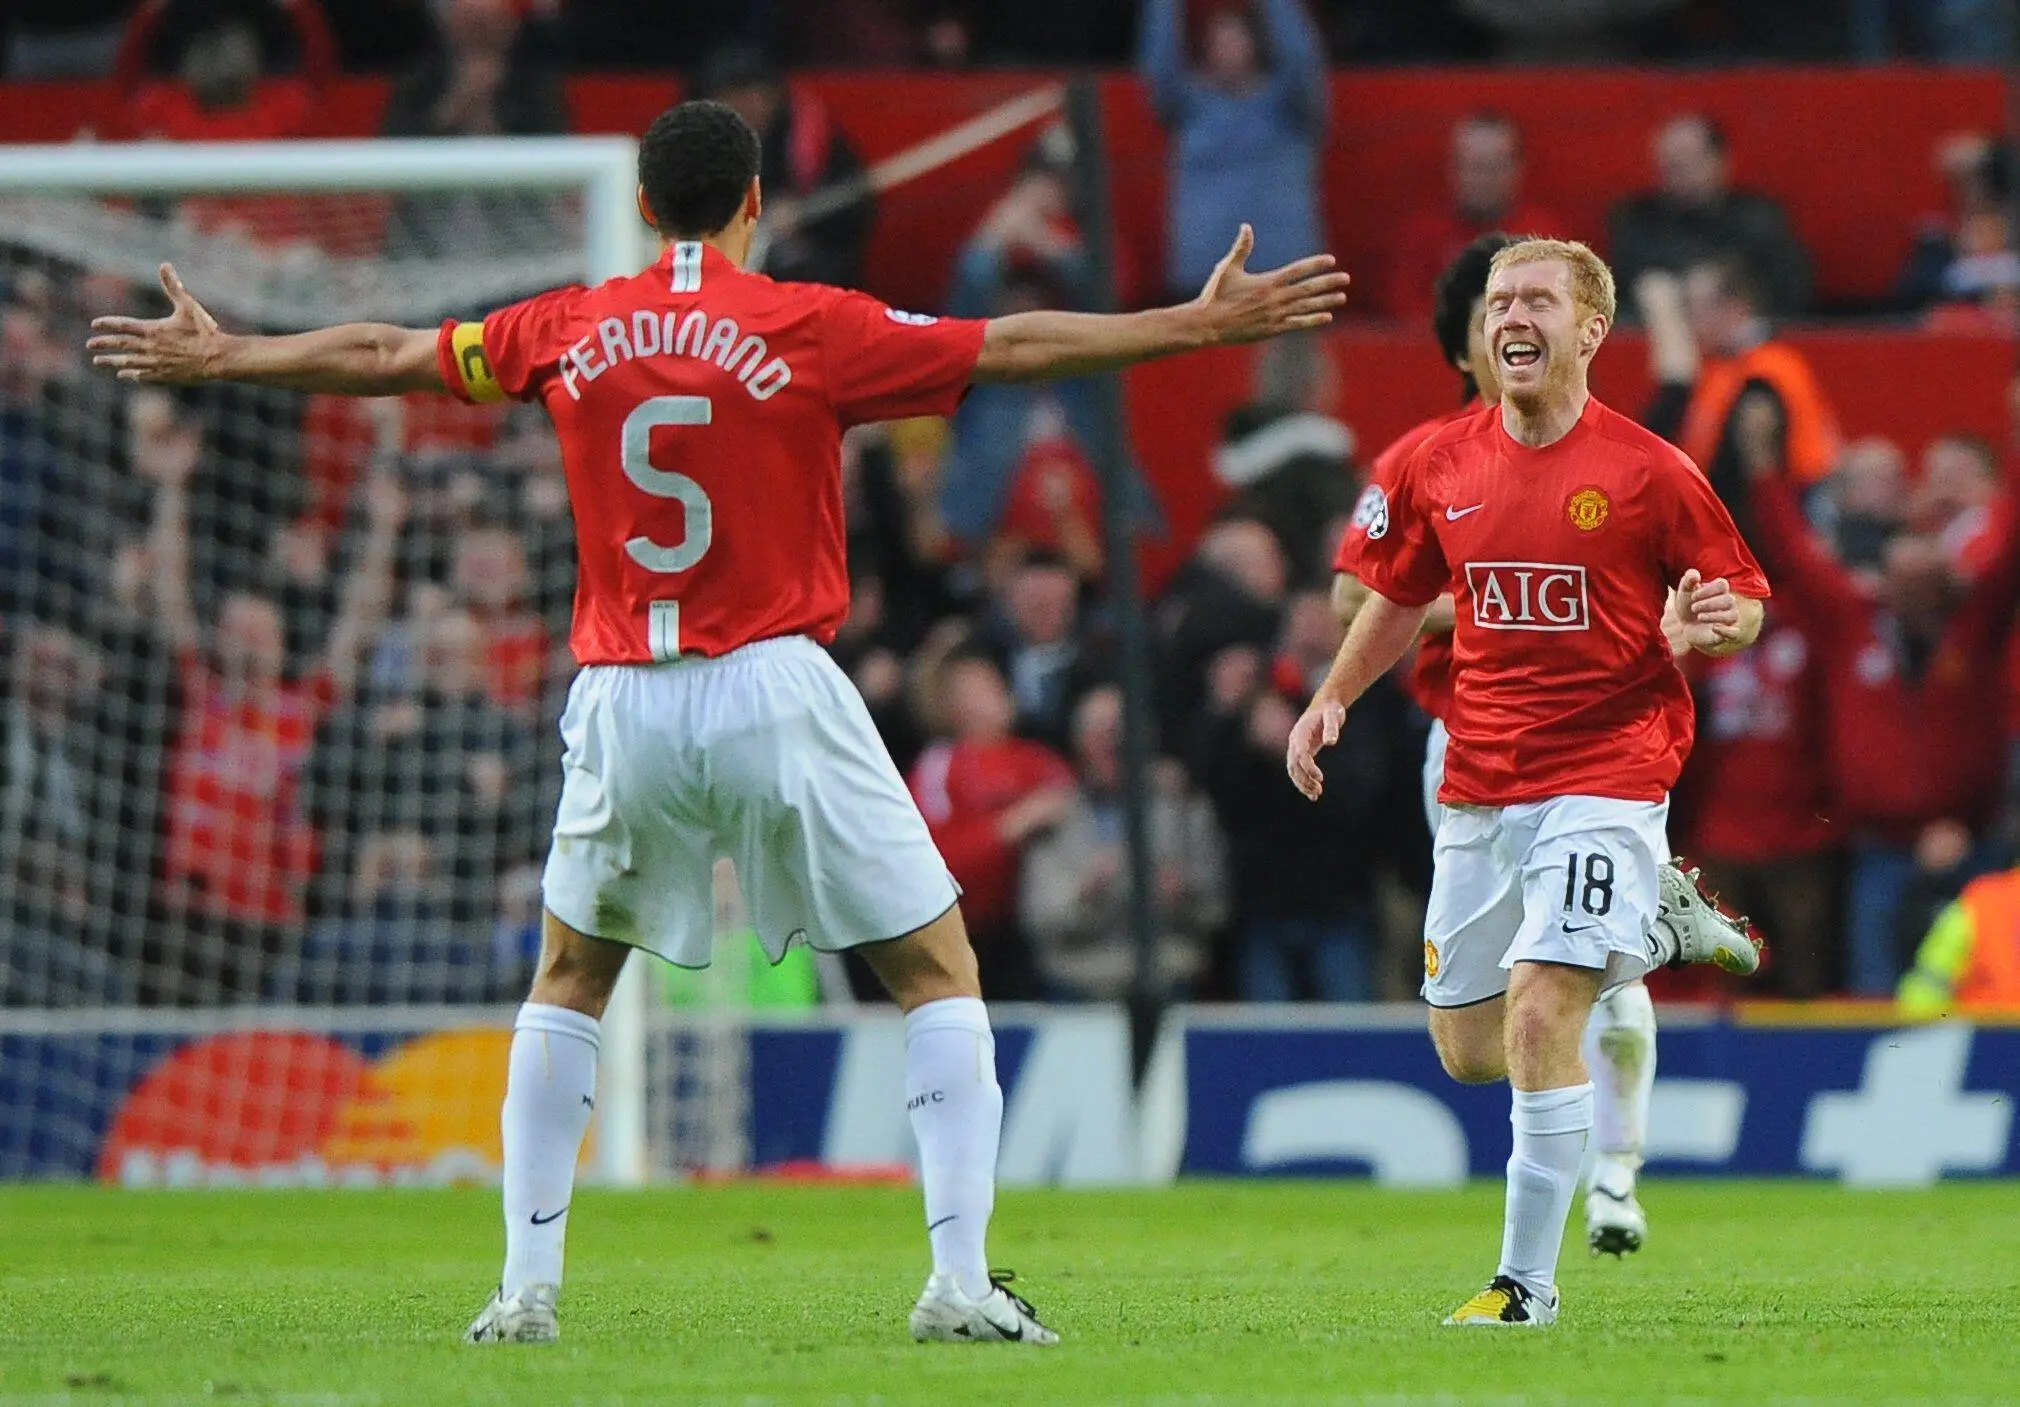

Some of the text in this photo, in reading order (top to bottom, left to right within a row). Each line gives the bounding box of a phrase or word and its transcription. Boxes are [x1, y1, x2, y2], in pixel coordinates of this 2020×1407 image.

[558, 309, 793, 401] FERDINAND
[621, 395, 712, 574] 5
[1479, 570, 1580, 624] AIG
[1562, 852, 1615, 917] 18
